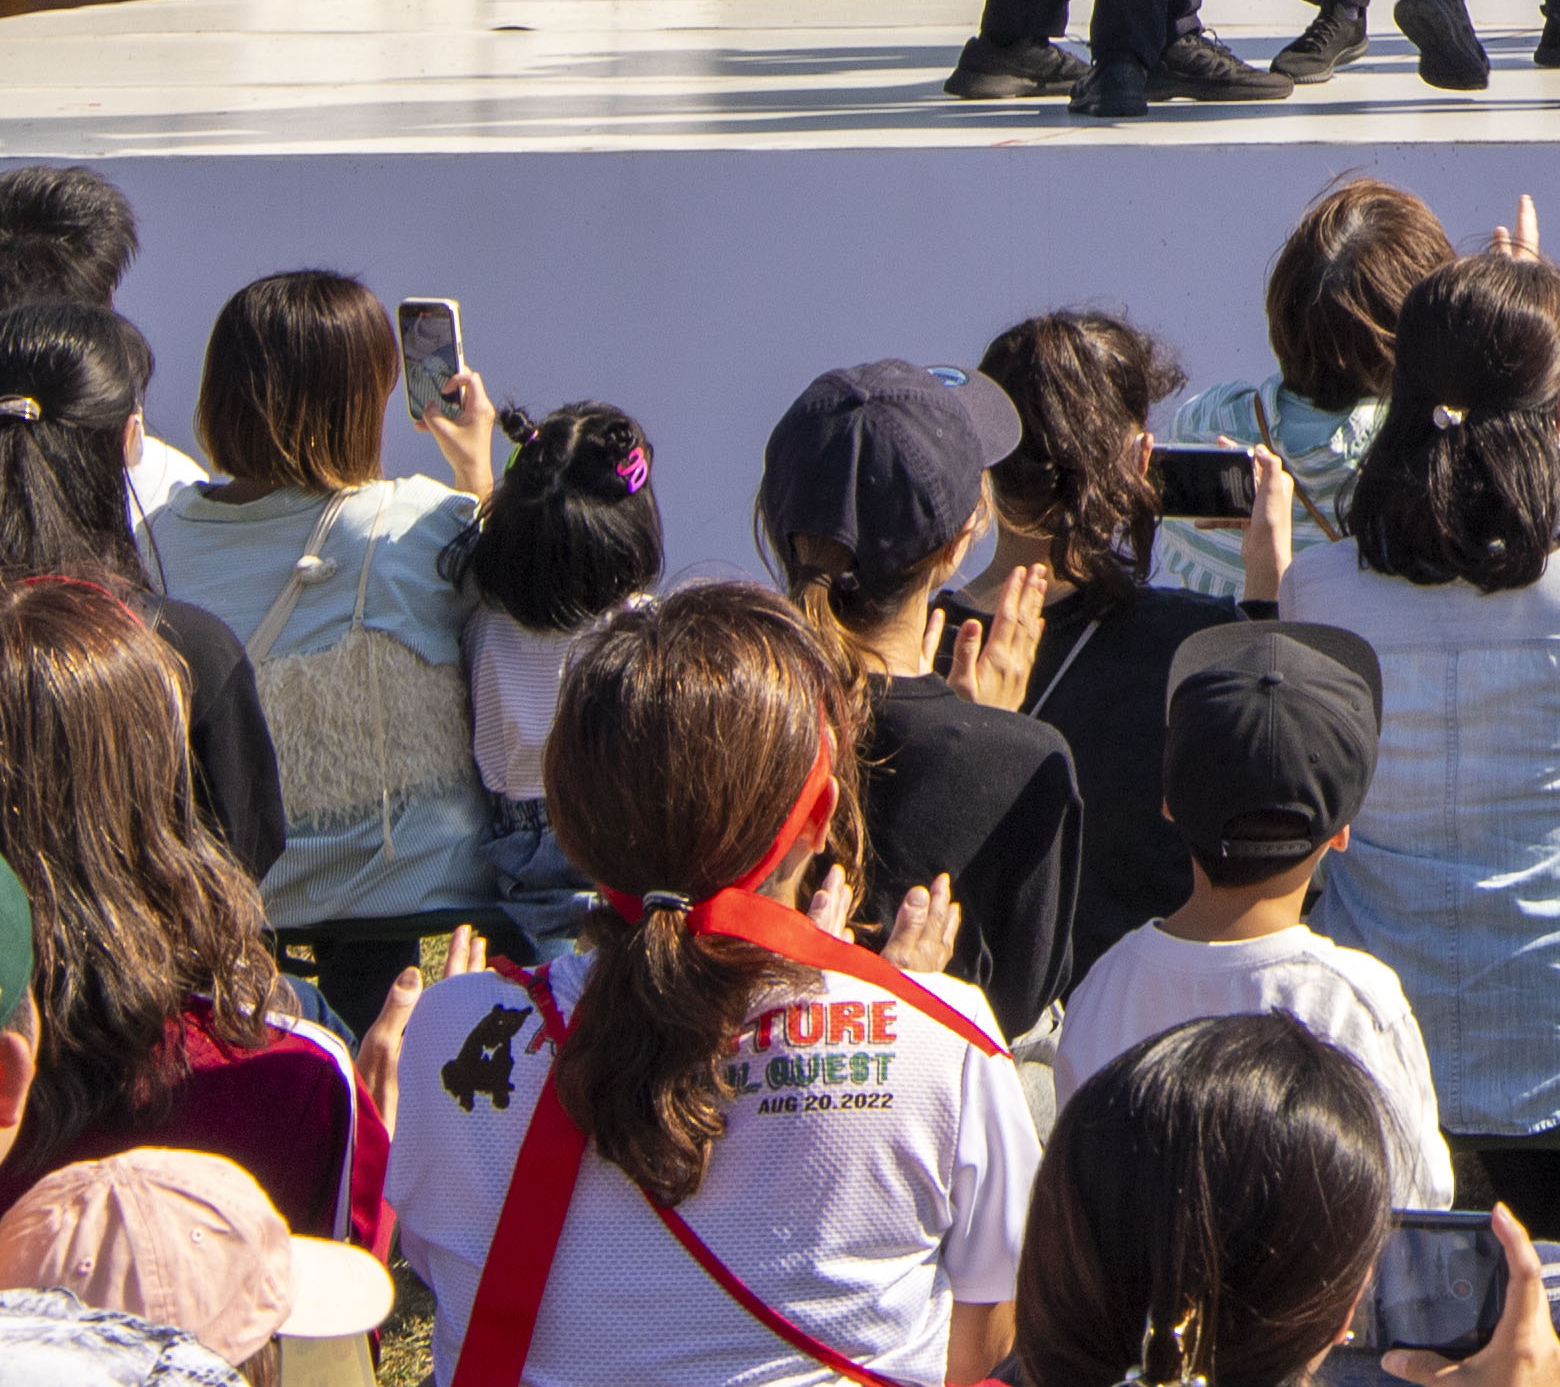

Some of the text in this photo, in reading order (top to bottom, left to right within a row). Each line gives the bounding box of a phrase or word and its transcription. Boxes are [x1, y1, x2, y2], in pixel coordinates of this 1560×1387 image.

[765, 1051, 896, 1091] QUEST
[757, 1092, 895, 1115] AUG 20.2022
